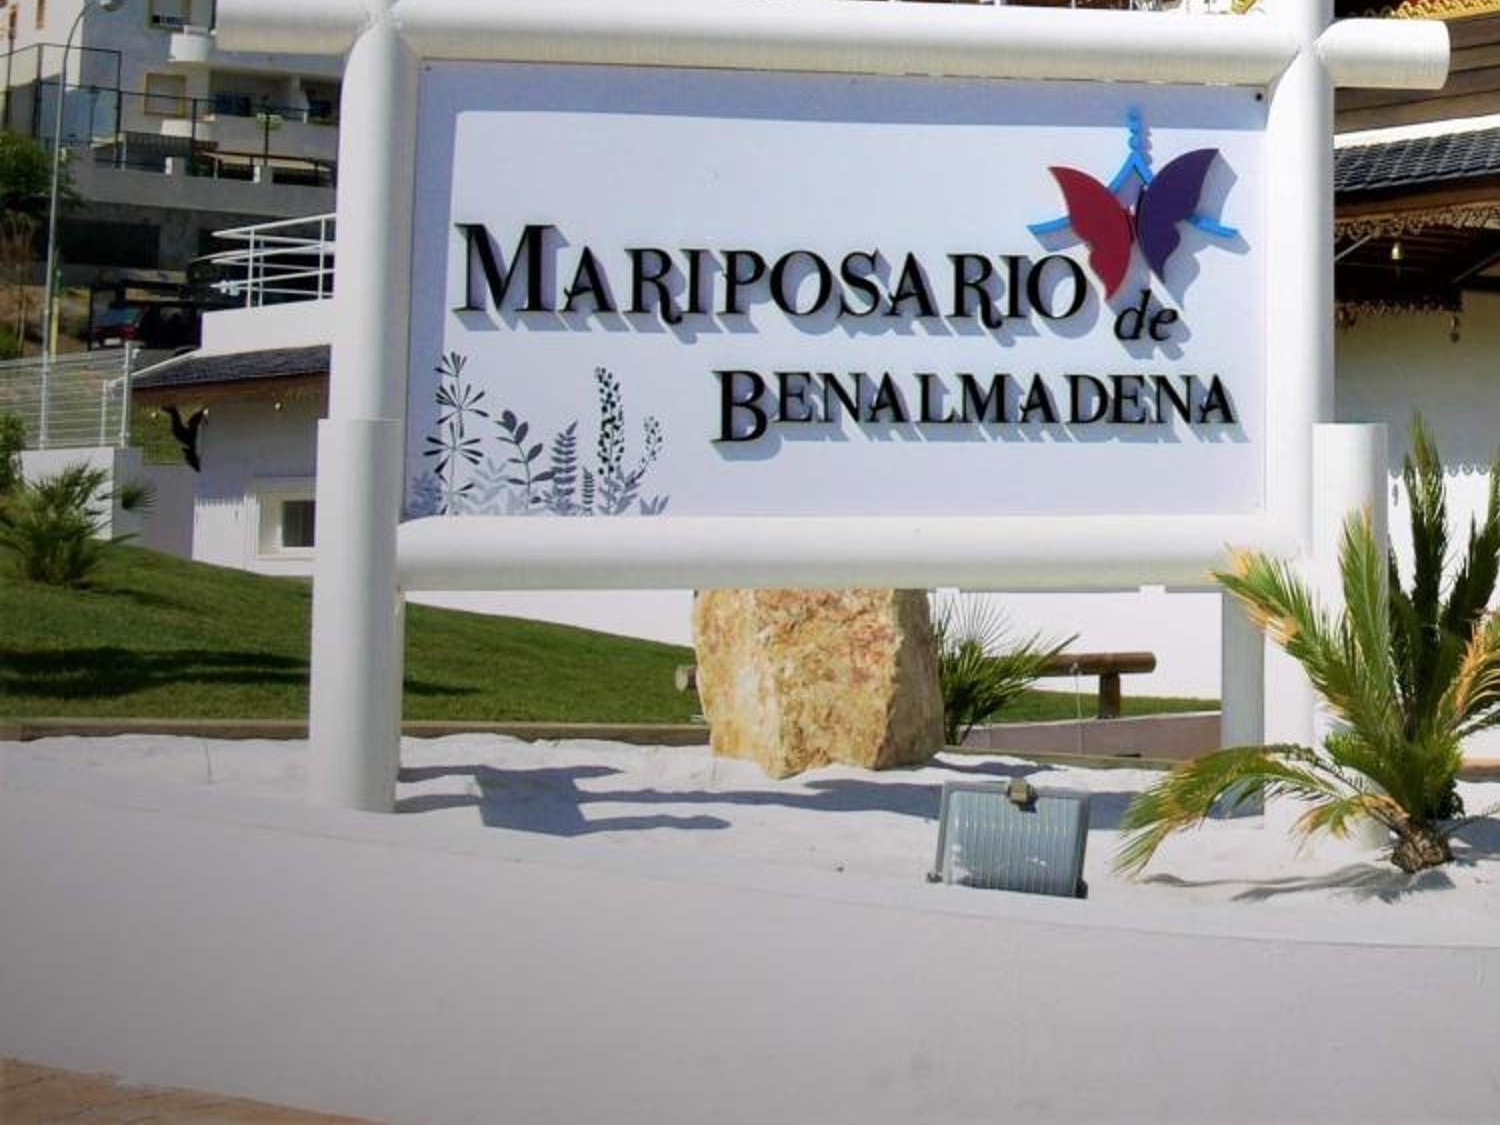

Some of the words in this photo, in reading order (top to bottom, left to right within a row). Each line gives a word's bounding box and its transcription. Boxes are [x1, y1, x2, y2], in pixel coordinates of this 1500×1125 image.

[455, 222, 1088, 328] MARIPOSARIO
[1114, 289, 1179, 342] de
[711, 368, 1238, 443] BENALMADENA
